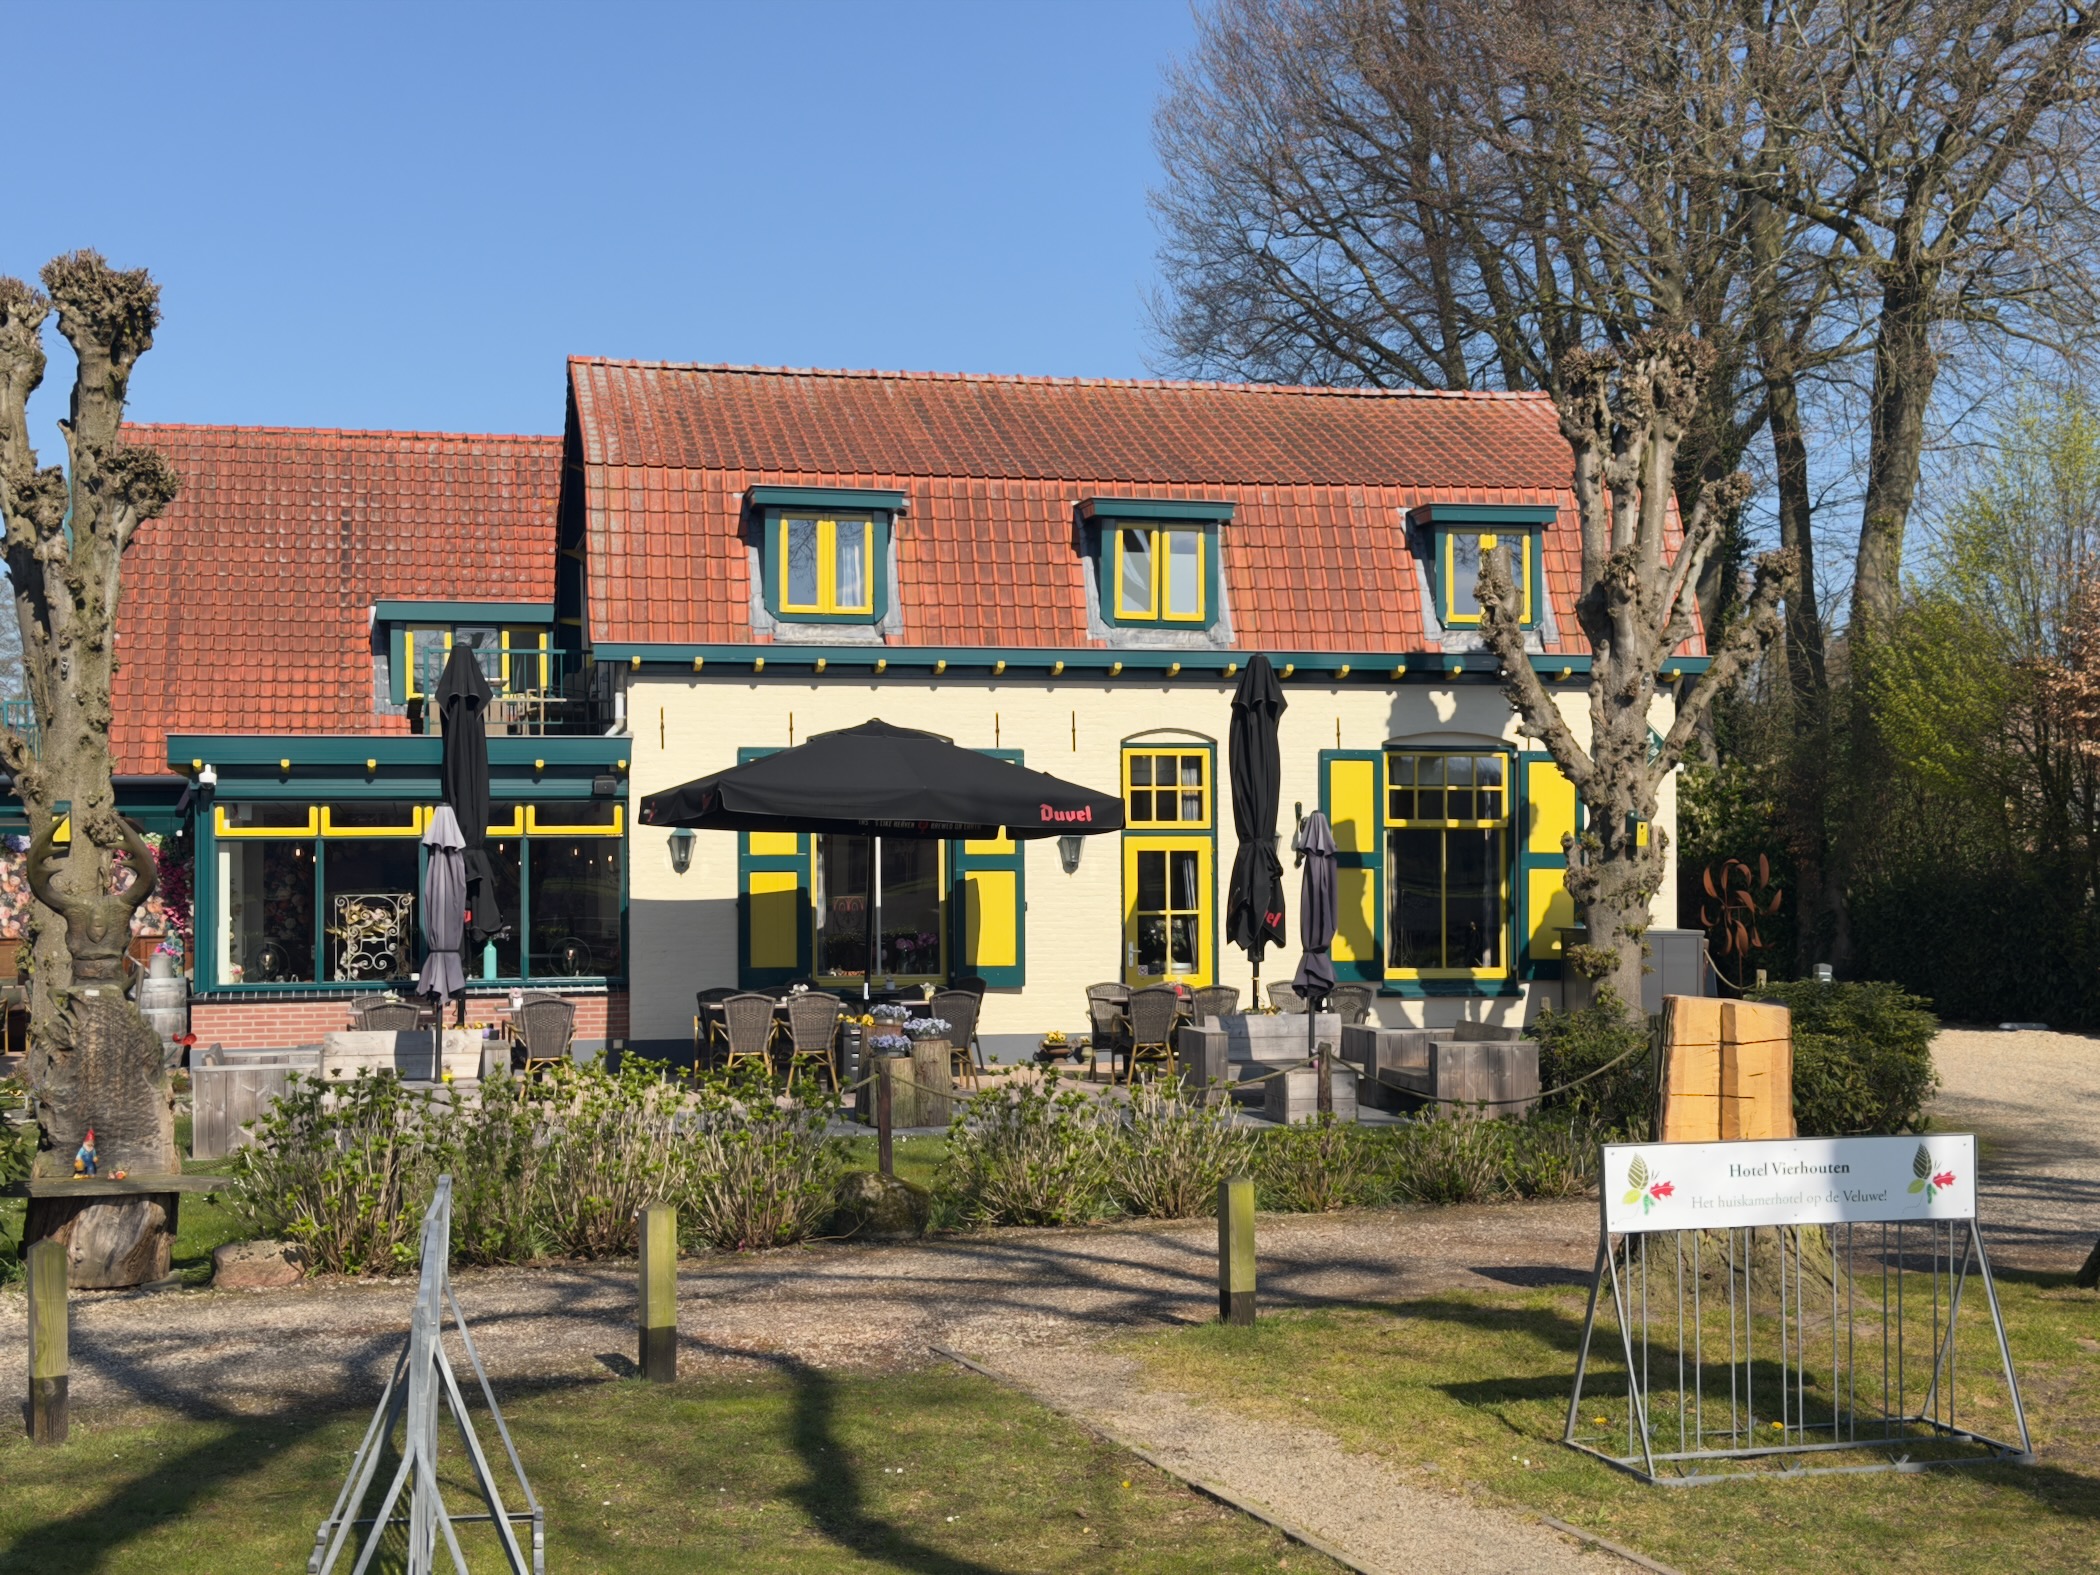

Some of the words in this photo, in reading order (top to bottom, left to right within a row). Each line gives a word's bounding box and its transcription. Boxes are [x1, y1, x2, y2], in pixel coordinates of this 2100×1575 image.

[1039, 803, 1092, 822] Duvel
[1729, 1162, 1768, 1178] Hotel
[1772, 1161, 1850, 1175] Vierhouten
[1692, 1196, 1714, 1209] Het
[1717, 1192, 1803, 1208] huiskamerhotel
[1806, 1194, 1822, 1206] op
[1825, 1190, 1839, 1203] de
[1842, 1189, 1887, 1202] Veluwe!
